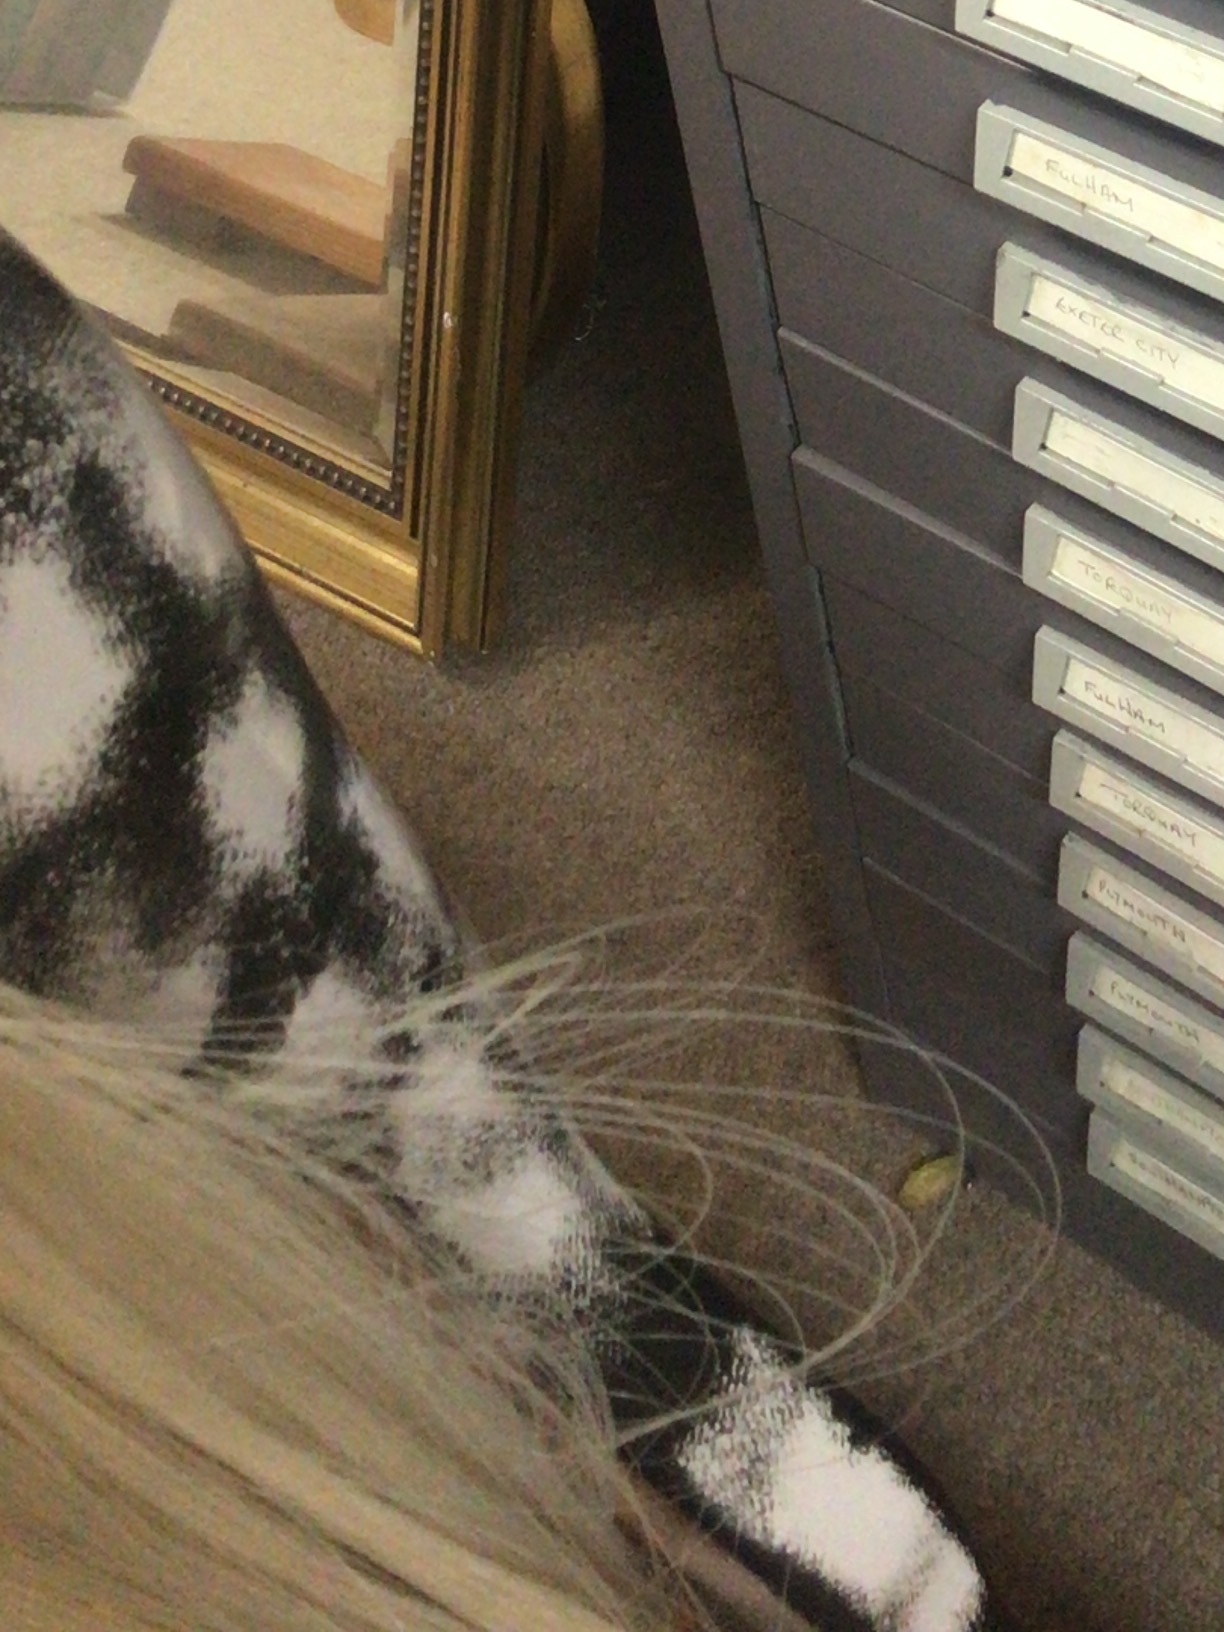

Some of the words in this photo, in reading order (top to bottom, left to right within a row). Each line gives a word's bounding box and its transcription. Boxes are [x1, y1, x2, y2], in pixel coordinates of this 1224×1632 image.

[1045, 158, 1134, 213] FULHAM
[1135, 338, 1181, 370] CITY
[1077, 558, 1174, 625] TORQUAY
